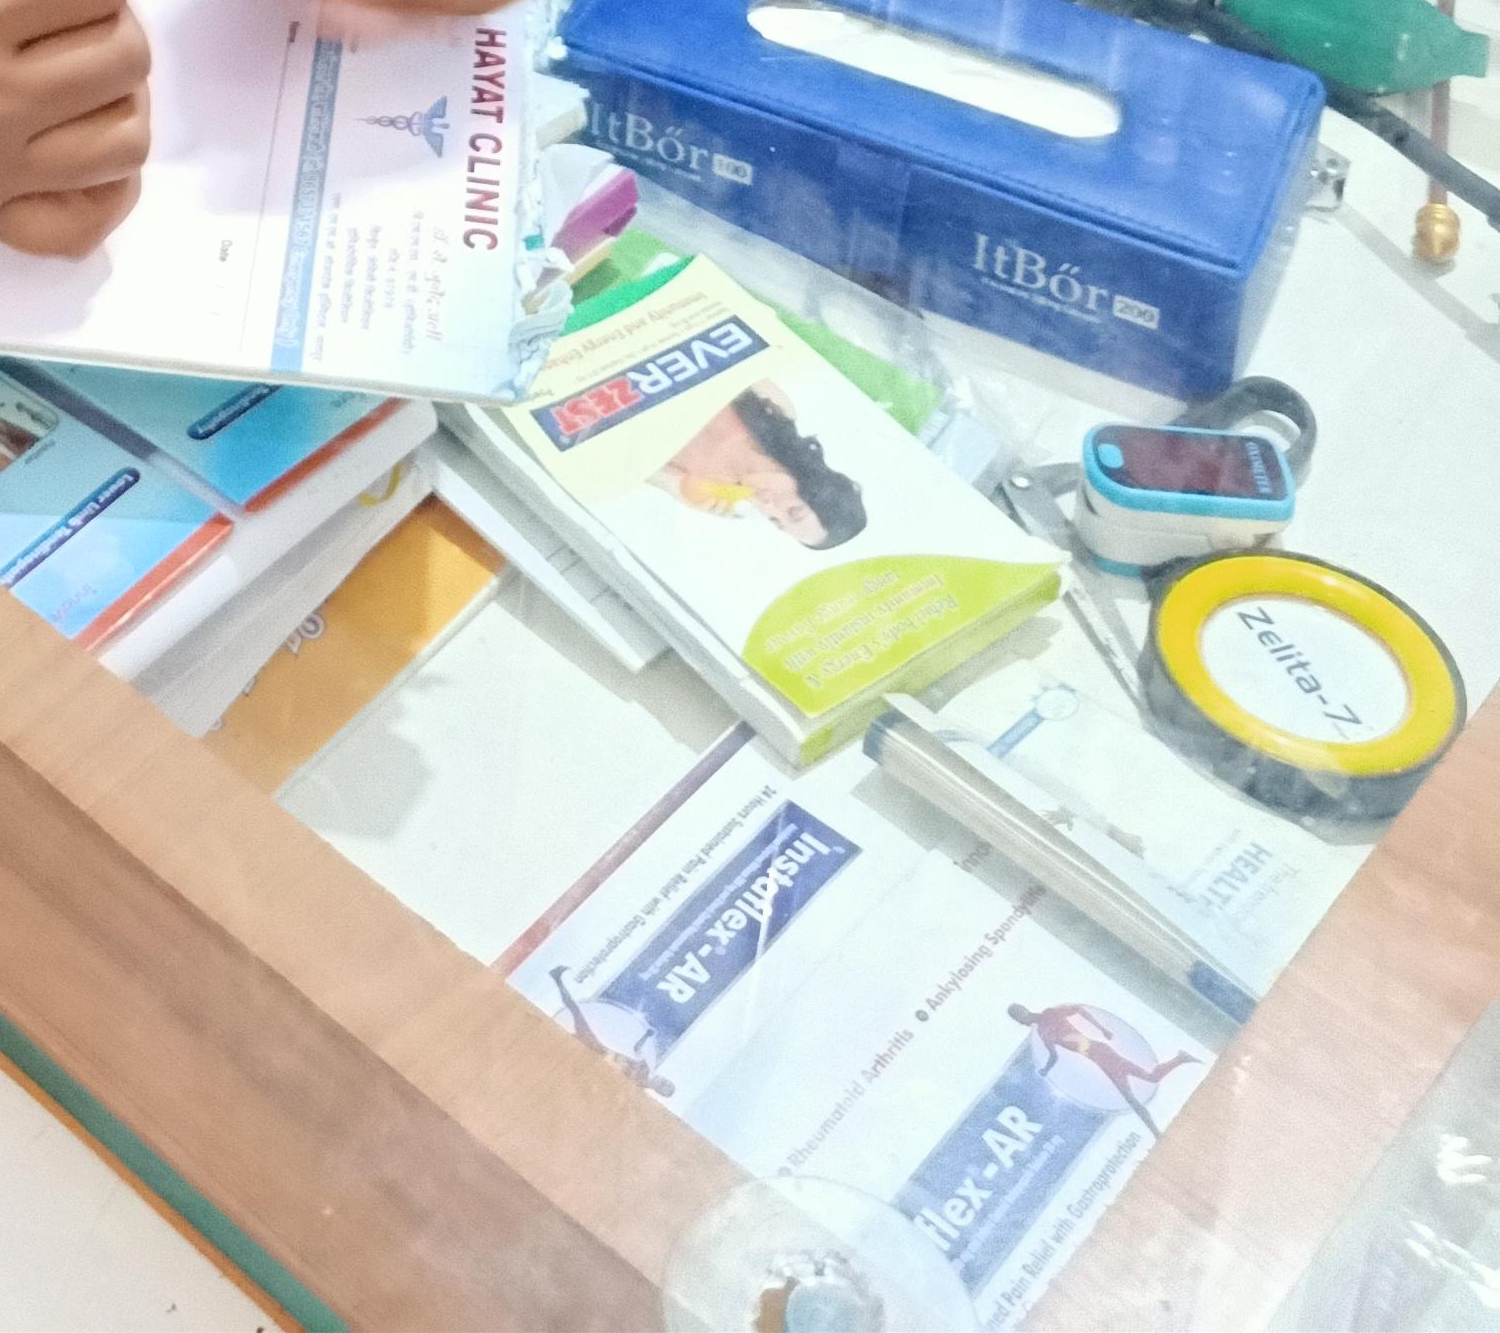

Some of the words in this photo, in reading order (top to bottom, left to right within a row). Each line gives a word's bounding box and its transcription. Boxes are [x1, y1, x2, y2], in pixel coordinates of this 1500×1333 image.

[469, 26, 508, 124] HAYAT
[462, 131, 503, 253] CLINIC
[924, 936, 994, 1014] Ankylosing
[786, 1079, 863, 1171] Rheumatoid
[859, 1026, 916, 1085] Arthritis
